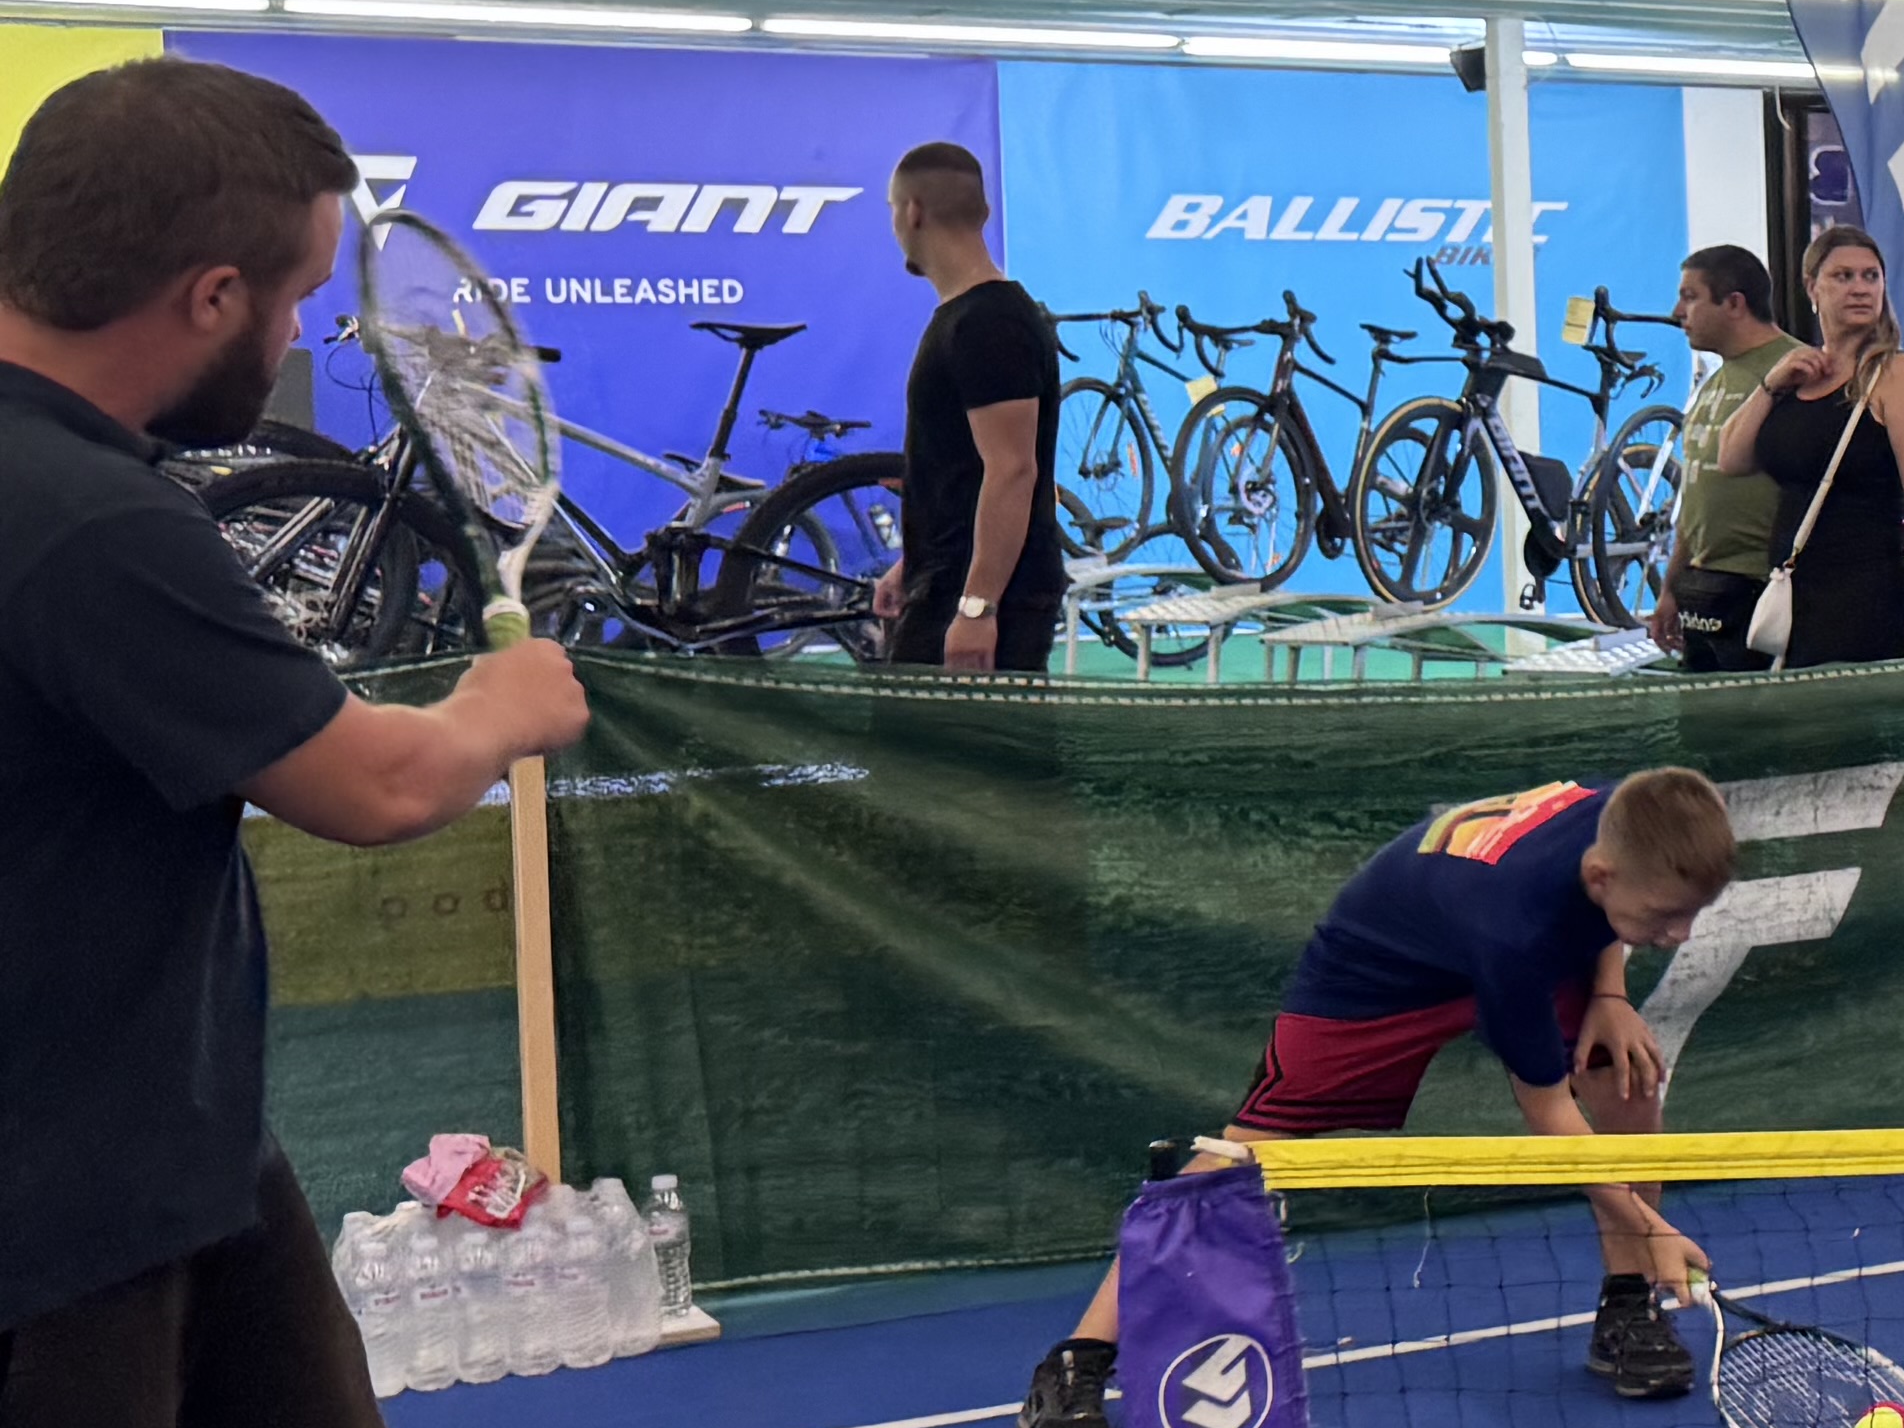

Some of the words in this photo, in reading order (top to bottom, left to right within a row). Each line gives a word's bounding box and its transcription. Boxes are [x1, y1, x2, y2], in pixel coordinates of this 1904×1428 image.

[472, 180, 864, 234] GIANT
[1146, 194, 1568, 242] BALLISTC
[545, 277, 744, 305] UNLEASHED
